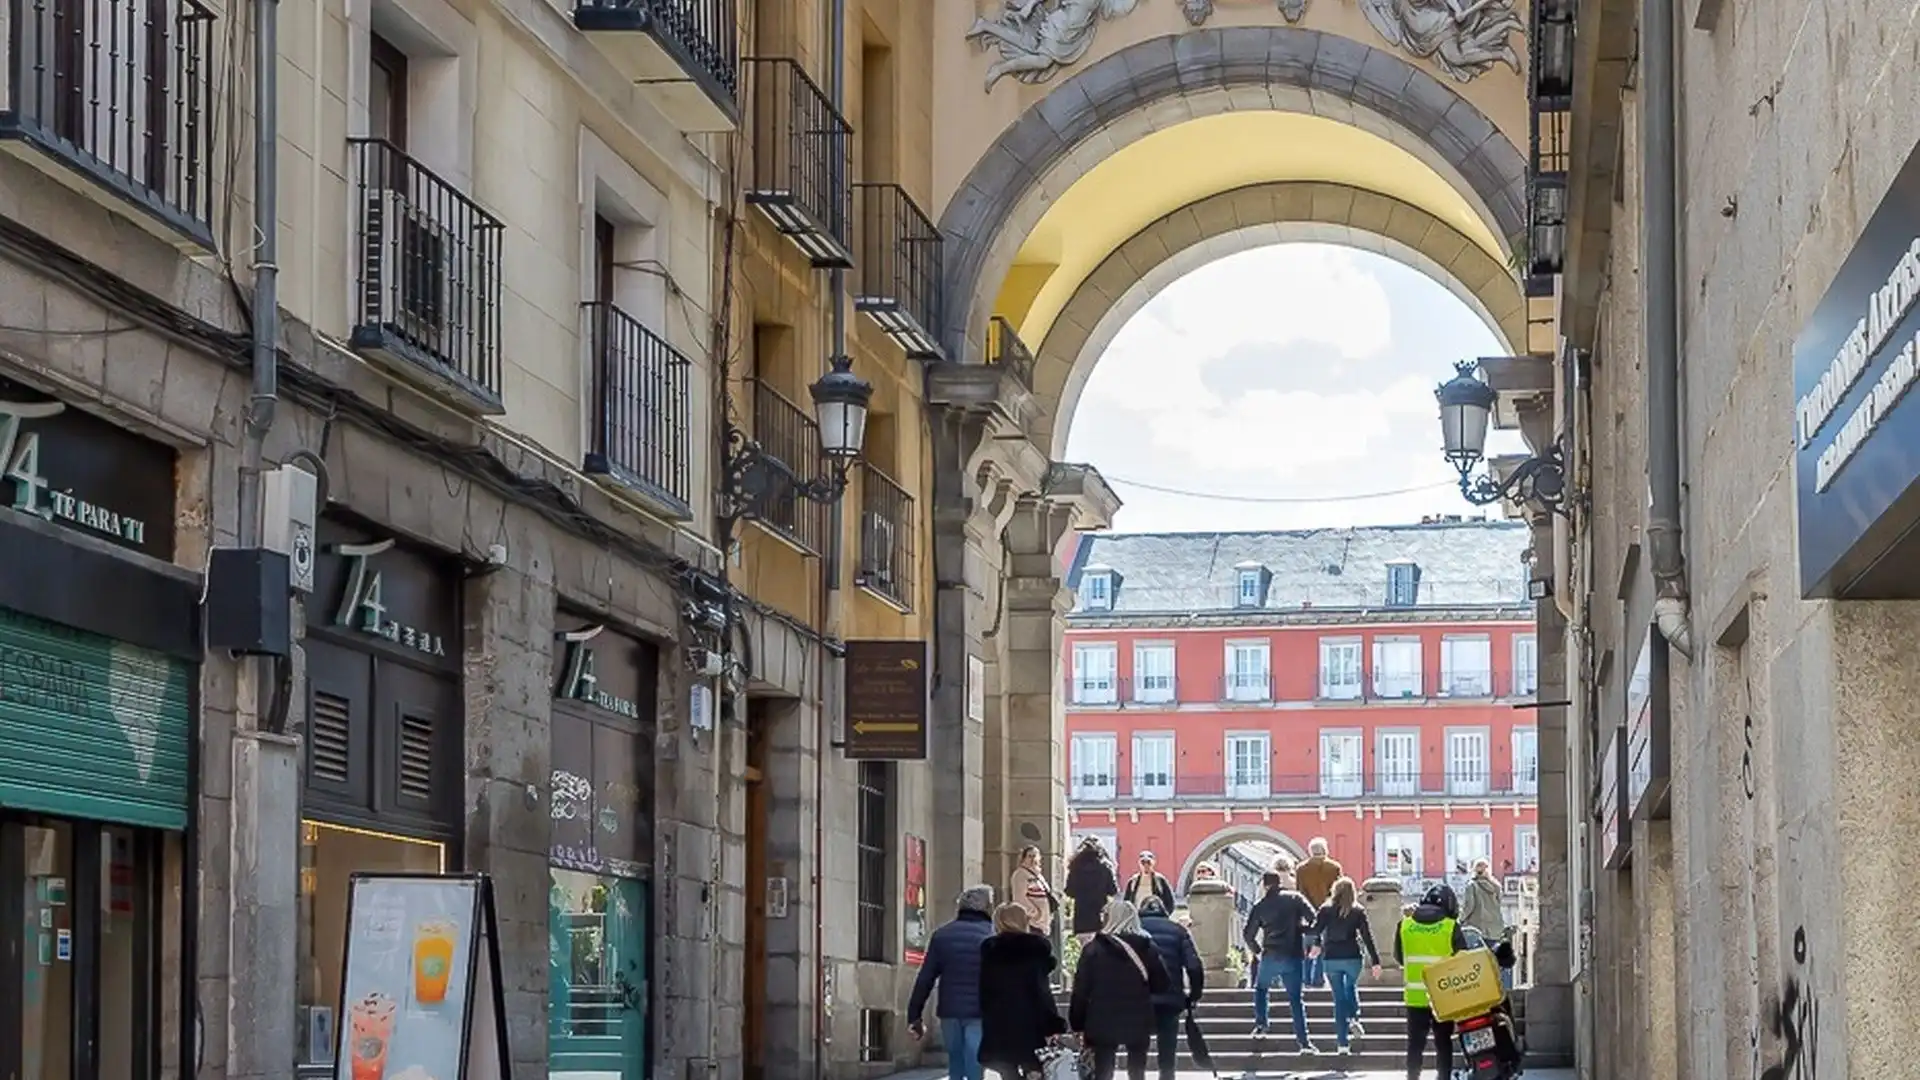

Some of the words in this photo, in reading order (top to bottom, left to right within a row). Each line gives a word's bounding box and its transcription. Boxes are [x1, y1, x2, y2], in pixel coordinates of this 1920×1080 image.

[50, 488, 76, 520] TÉ
[77, 500, 122, 537] PARA
[123, 516, 145, 544] TI
[1437, 966, 1481, 990] Glovo
